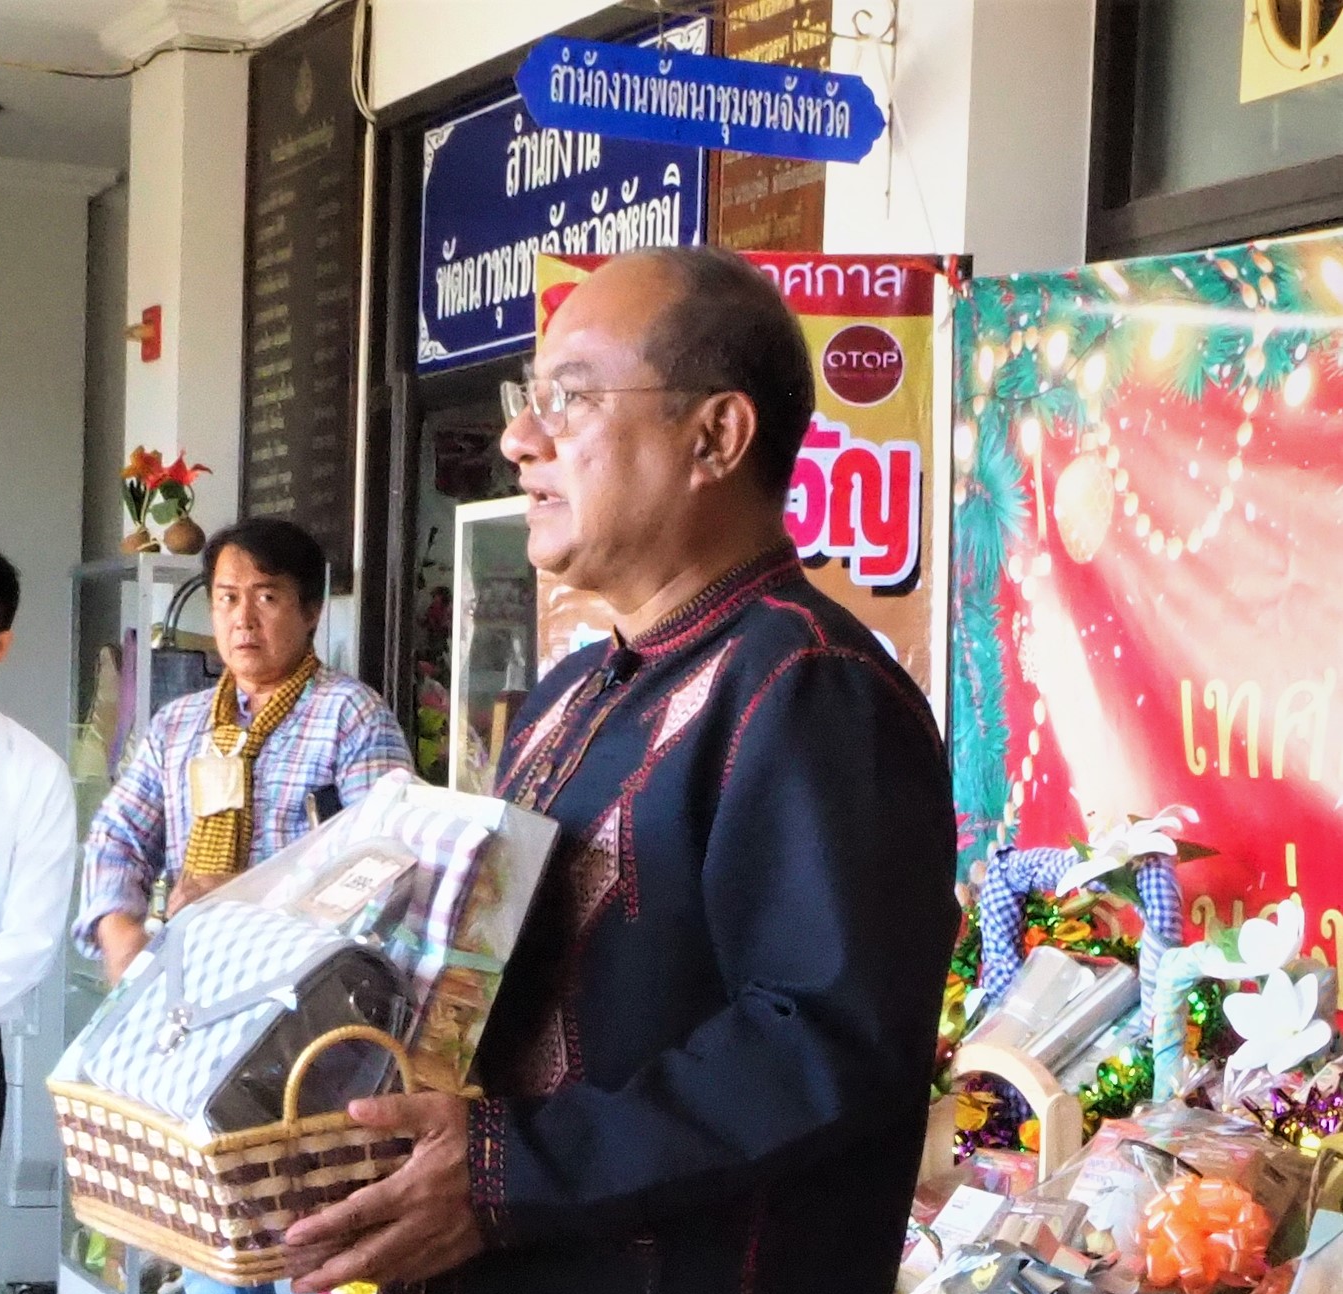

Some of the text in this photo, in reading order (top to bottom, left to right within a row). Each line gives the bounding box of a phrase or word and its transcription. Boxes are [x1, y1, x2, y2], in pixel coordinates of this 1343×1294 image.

[550, 47, 850, 144] สำนักงานพัฒนาชุมชนจังหวัด
[506, 113, 600, 197] สำนกงาน
[760, 262, 902, 297] ศกาล
[827, 351, 898, 369] OTOP
[785, 421, 911, 576] วัญ
[1181, 667, 1343, 781] เทศ
